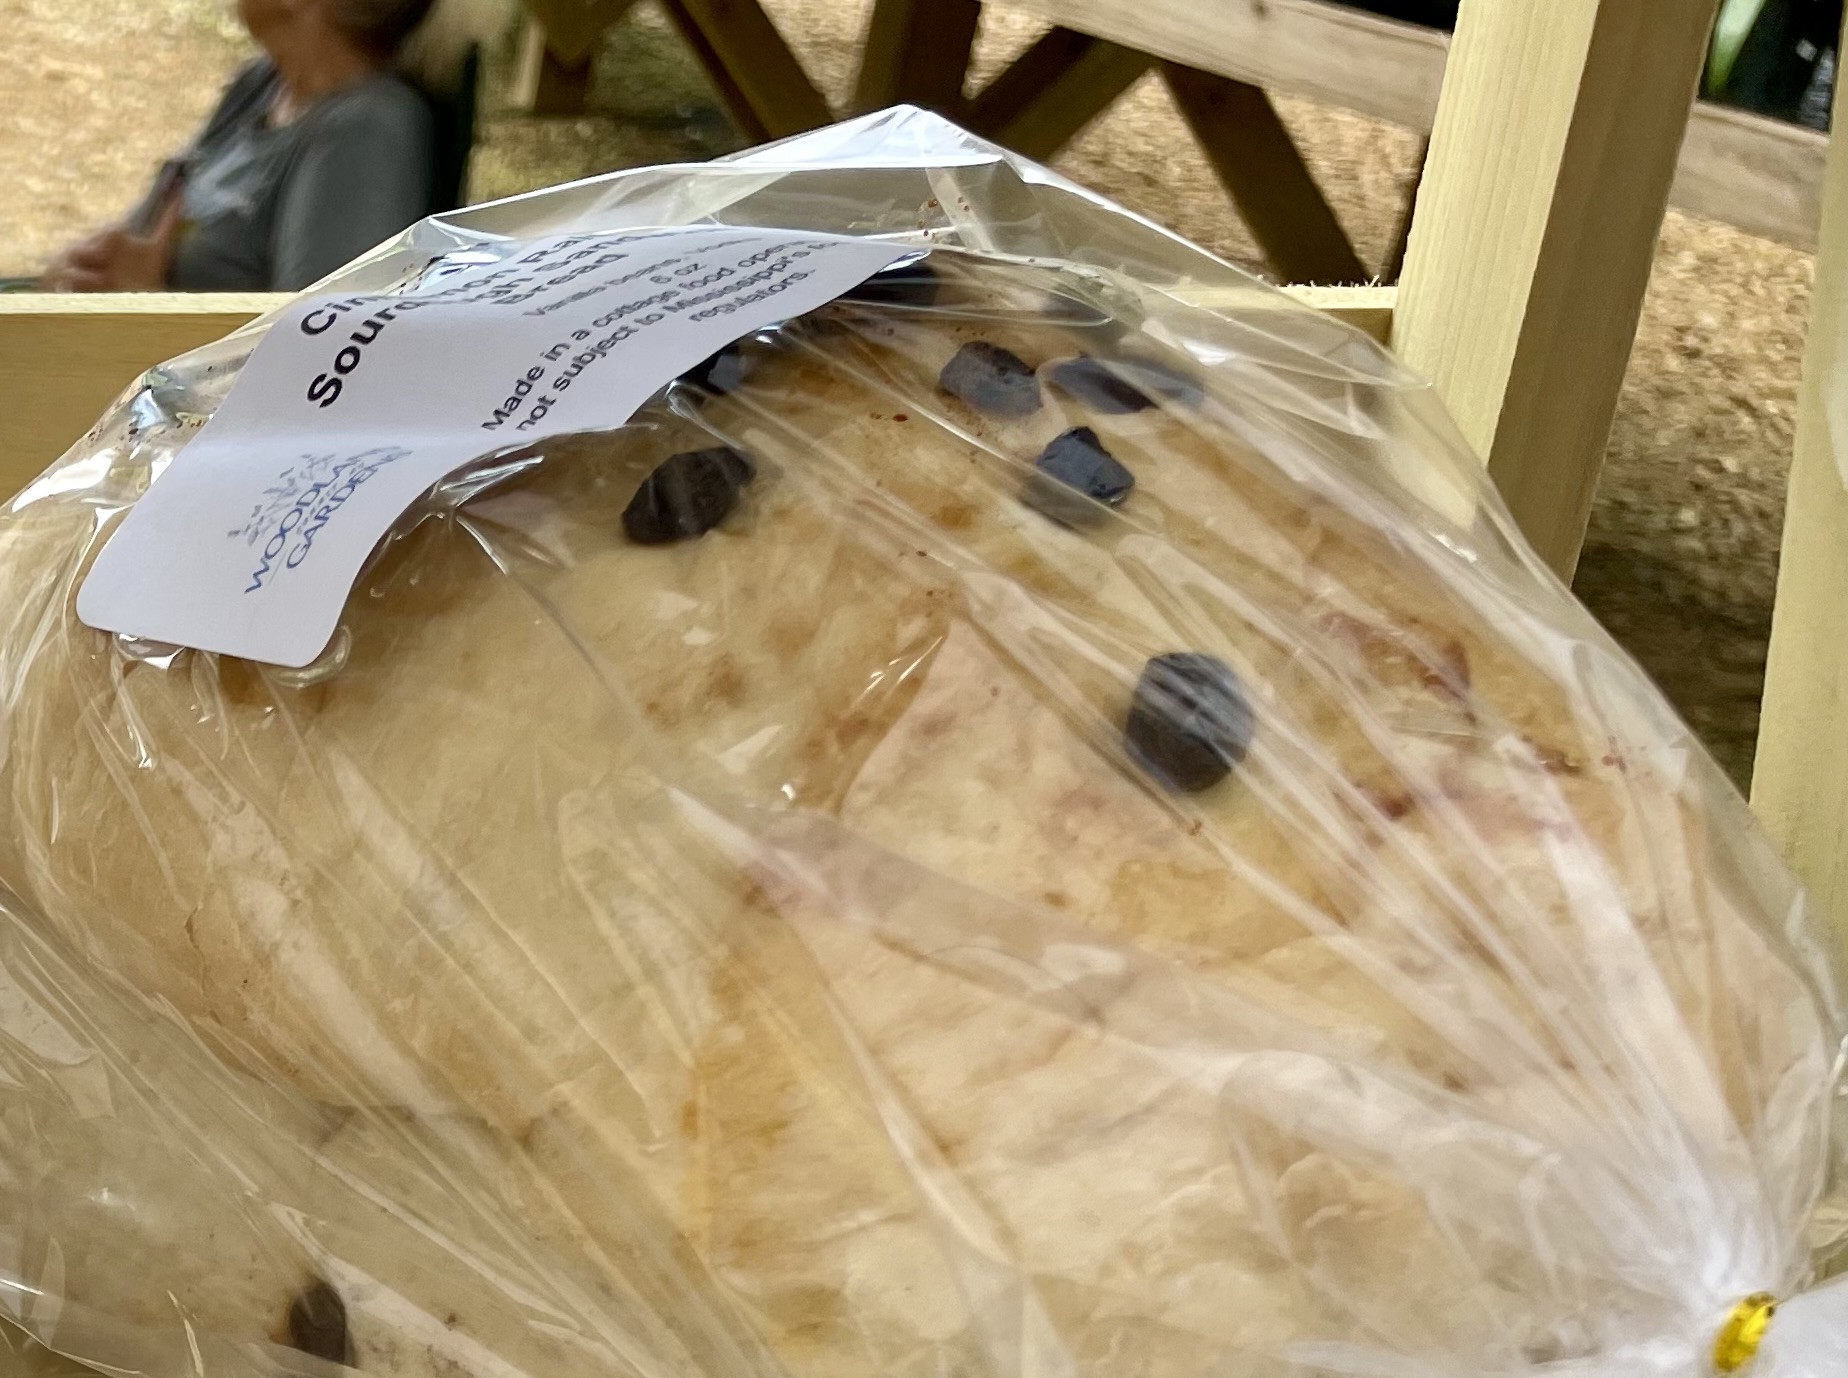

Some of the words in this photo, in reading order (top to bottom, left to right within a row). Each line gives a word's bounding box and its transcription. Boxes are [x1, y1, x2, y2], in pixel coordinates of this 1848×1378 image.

[481, 365, 545, 431] Made
[540, 342, 570, 363] in
[571, 328, 591, 341] a
[592, 289, 680, 329] cottage
[678, 267, 737, 290] food
[515, 394, 556, 432] not
[552, 324, 639, 392] subject
[633, 313, 665, 326] to
